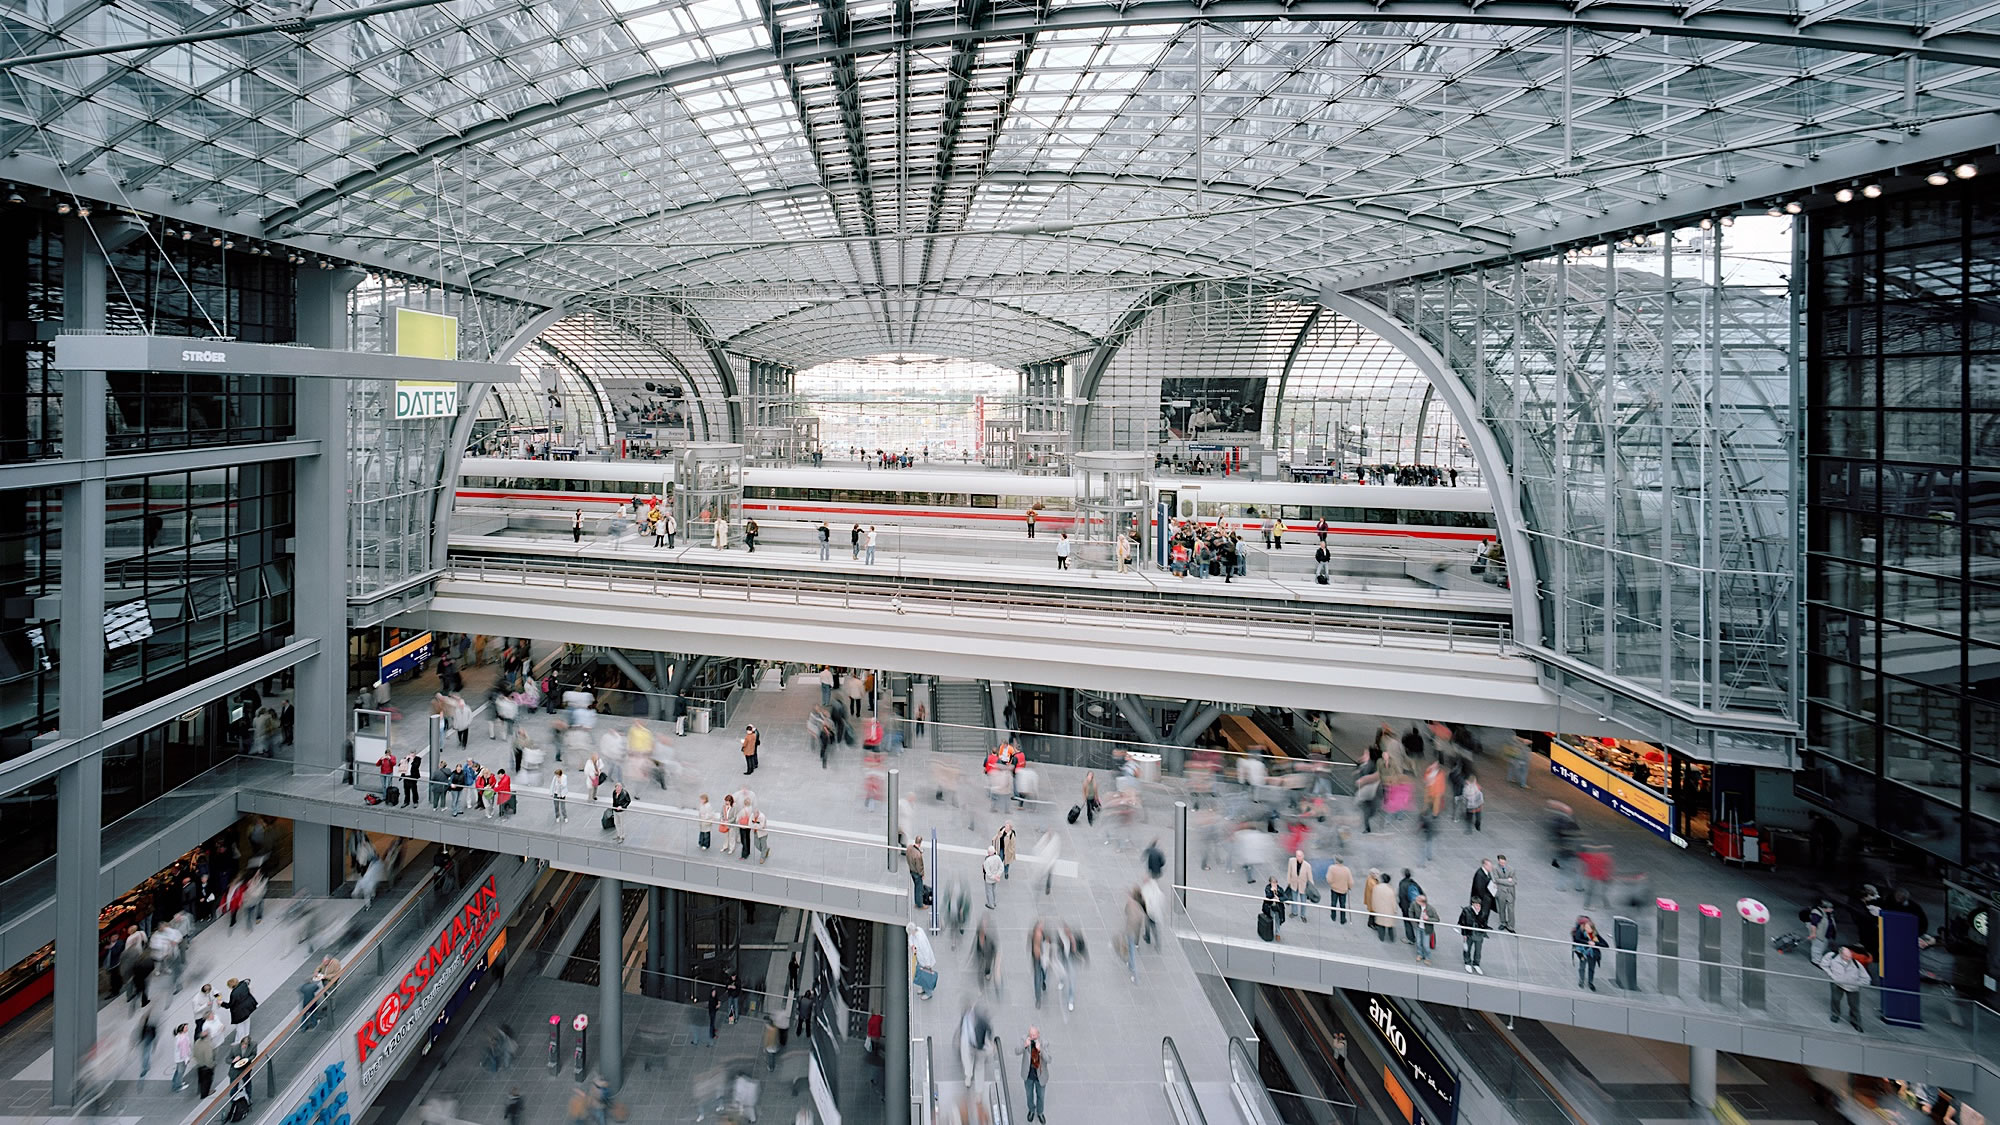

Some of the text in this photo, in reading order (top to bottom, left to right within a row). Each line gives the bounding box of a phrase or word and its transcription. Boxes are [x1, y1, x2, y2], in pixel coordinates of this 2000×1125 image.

[182, 350, 226, 363] STRÖER
[397, 391, 456, 417] DATEV
[1560, 766, 1579, 785] 11-16
[357, 875, 497, 1063] ROSSMANN
[1369, 997, 1407, 1056] arko
[383, 1027, 408, 1058] 1200
